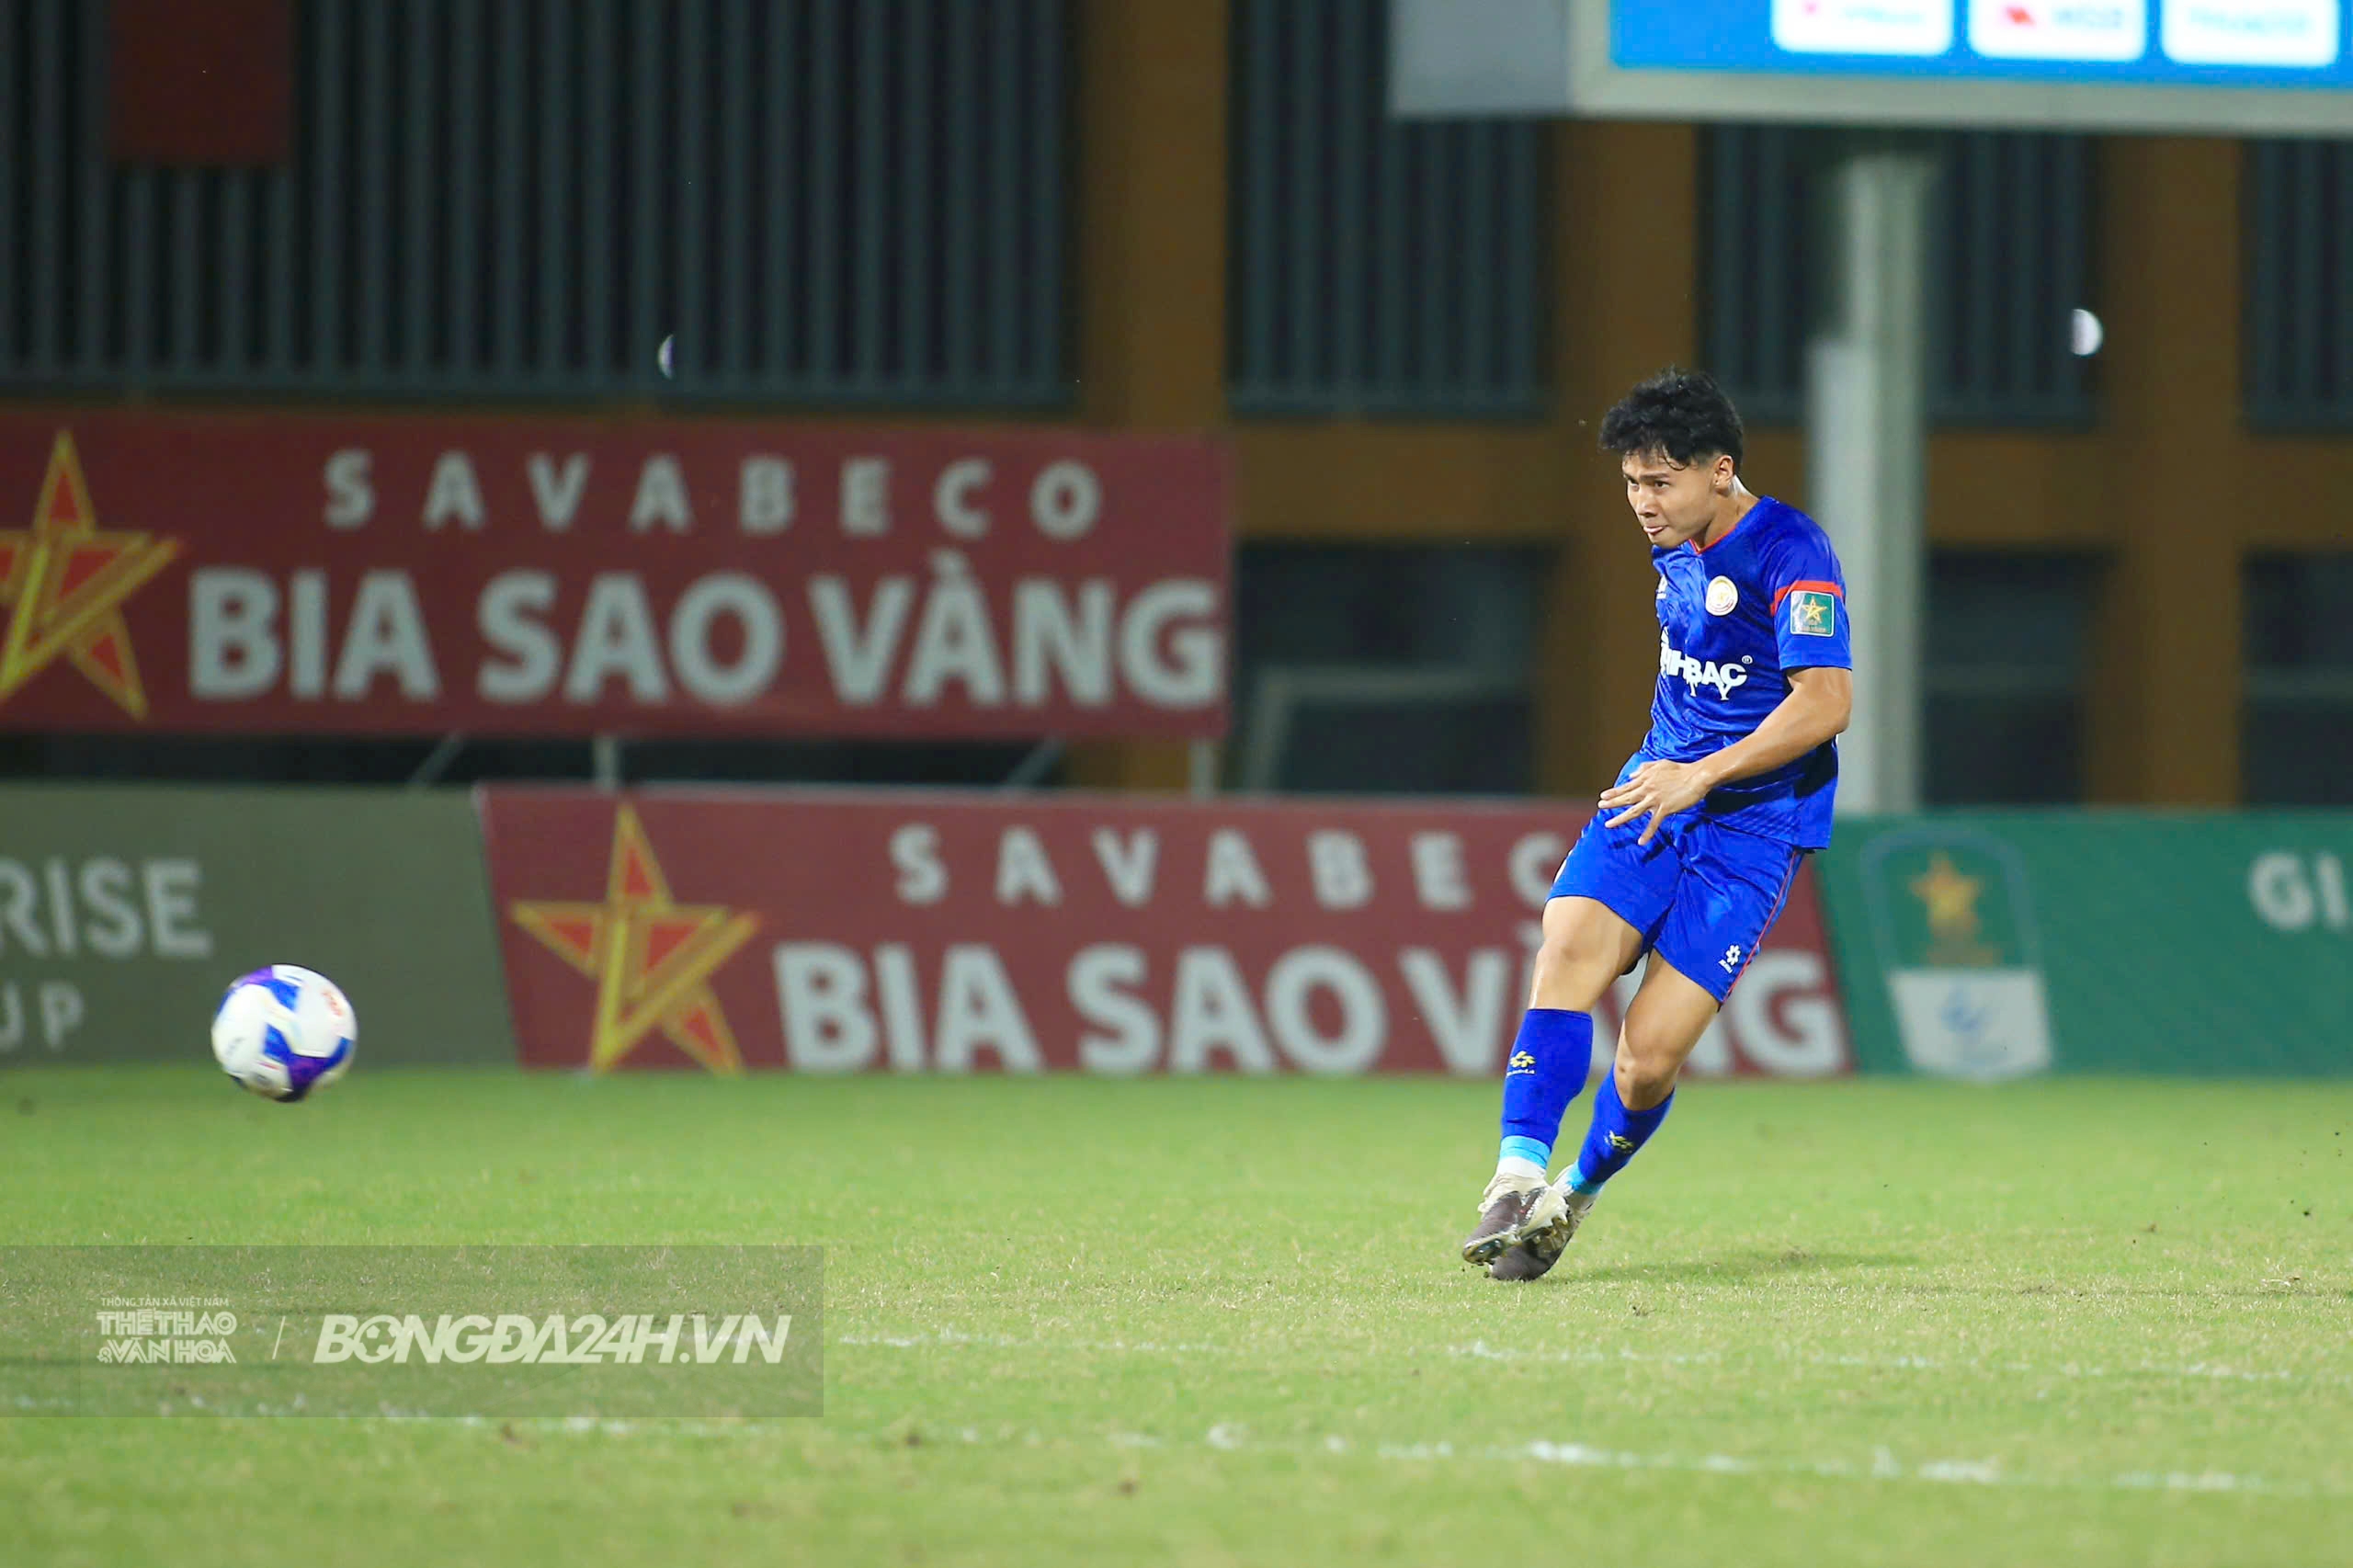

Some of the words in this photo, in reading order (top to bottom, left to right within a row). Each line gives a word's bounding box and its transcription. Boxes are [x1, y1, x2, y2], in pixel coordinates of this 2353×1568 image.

[324, 449, 1100, 540] SAVABECO
[189, 567, 440, 700] BIA
[478, 569, 784, 706] SAO
[808, 549, 1222, 709] VÀNG
[889, 824, 1566, 911] SAVABEC
[773, 941, 1044, 1073] BIA
[1066, 944, 1387, 1074] SAO
